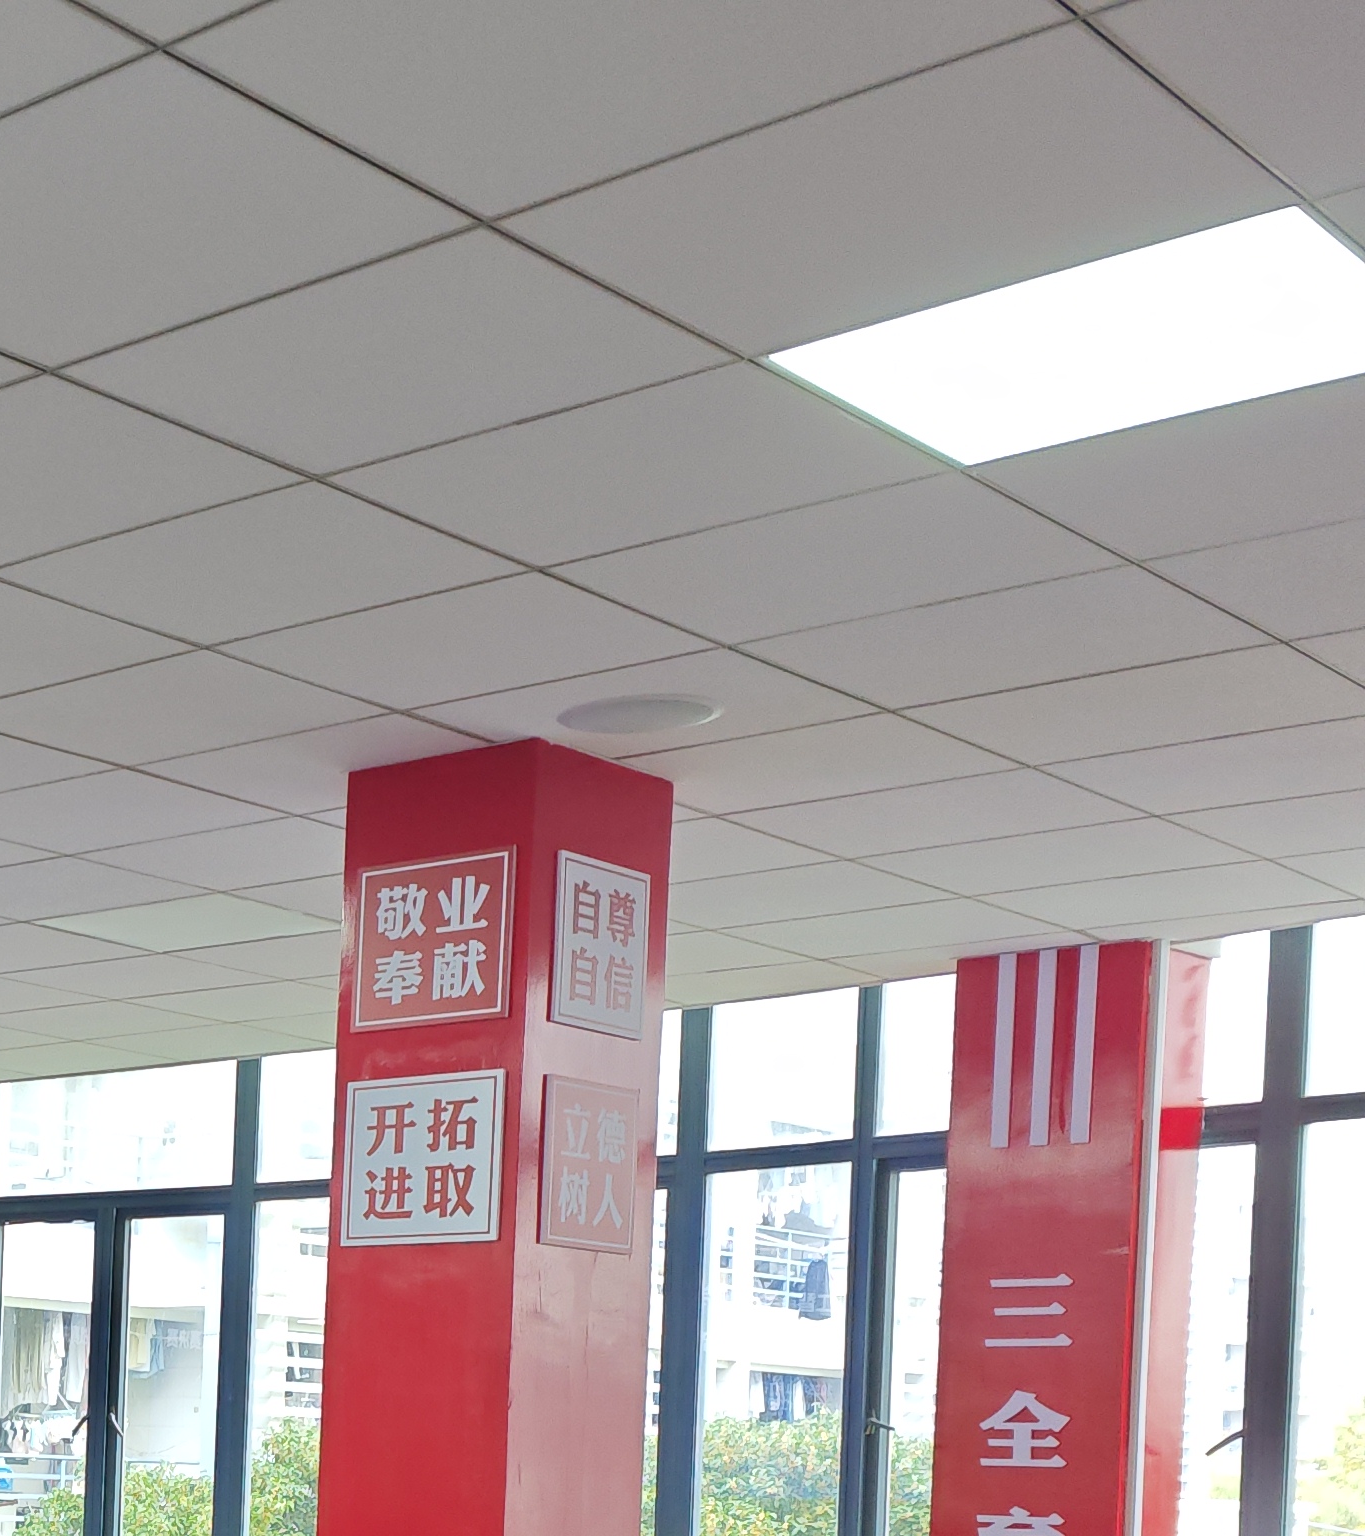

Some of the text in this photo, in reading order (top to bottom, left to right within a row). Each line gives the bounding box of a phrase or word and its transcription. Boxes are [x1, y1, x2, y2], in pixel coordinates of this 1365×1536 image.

[375, 875, 490, 942] 敬业
[573, 880, 636, 948] 自尊
[372, 942, 487, 1005] 奉献
[570, 946, 635, 1013] 自信
[366, 1096, 479, 1156] 开拓
[561, 1102, 627, 1167] 立德
[362, 1162, 477, 1221] 进取
[557, 1165, 624, 1230] 树人
